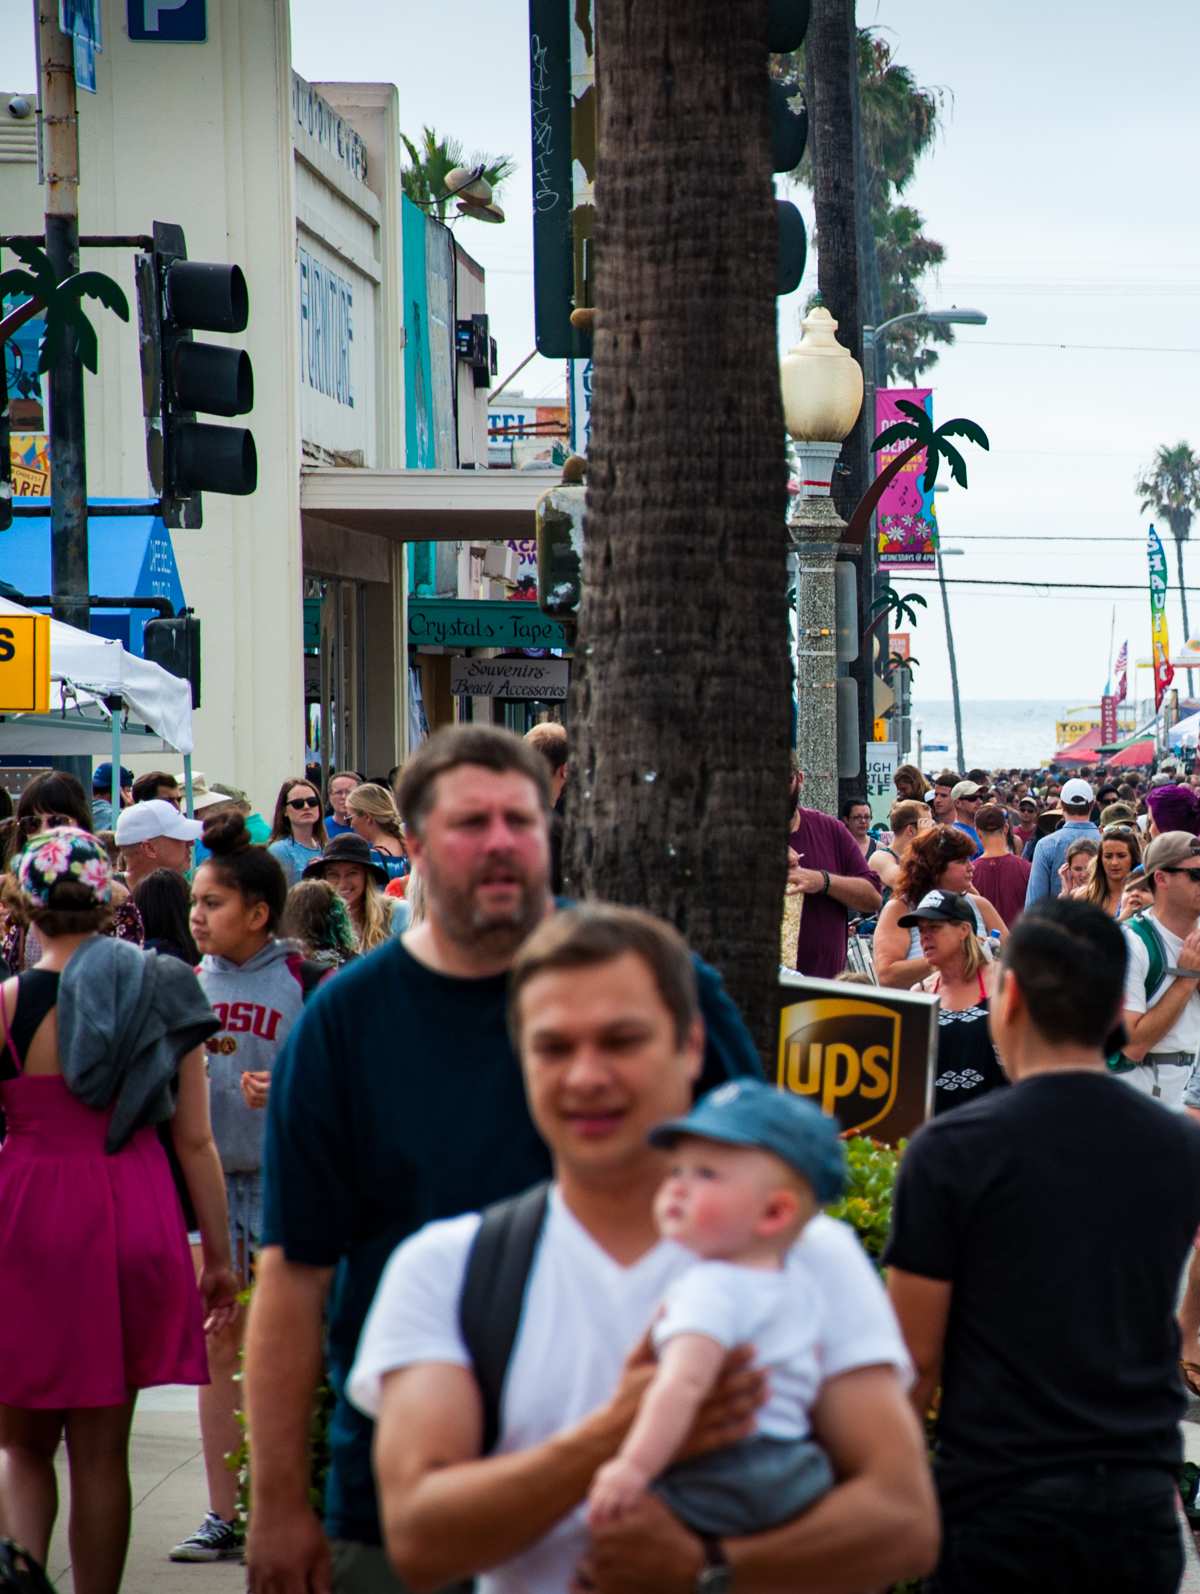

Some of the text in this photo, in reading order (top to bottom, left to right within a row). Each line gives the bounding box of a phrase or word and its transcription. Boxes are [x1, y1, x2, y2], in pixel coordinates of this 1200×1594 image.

[409, 612, 495, 643] Crystals
[451, 678, 566, 697] Beach Accessories
[787, 1042, 890, 1117] ups
